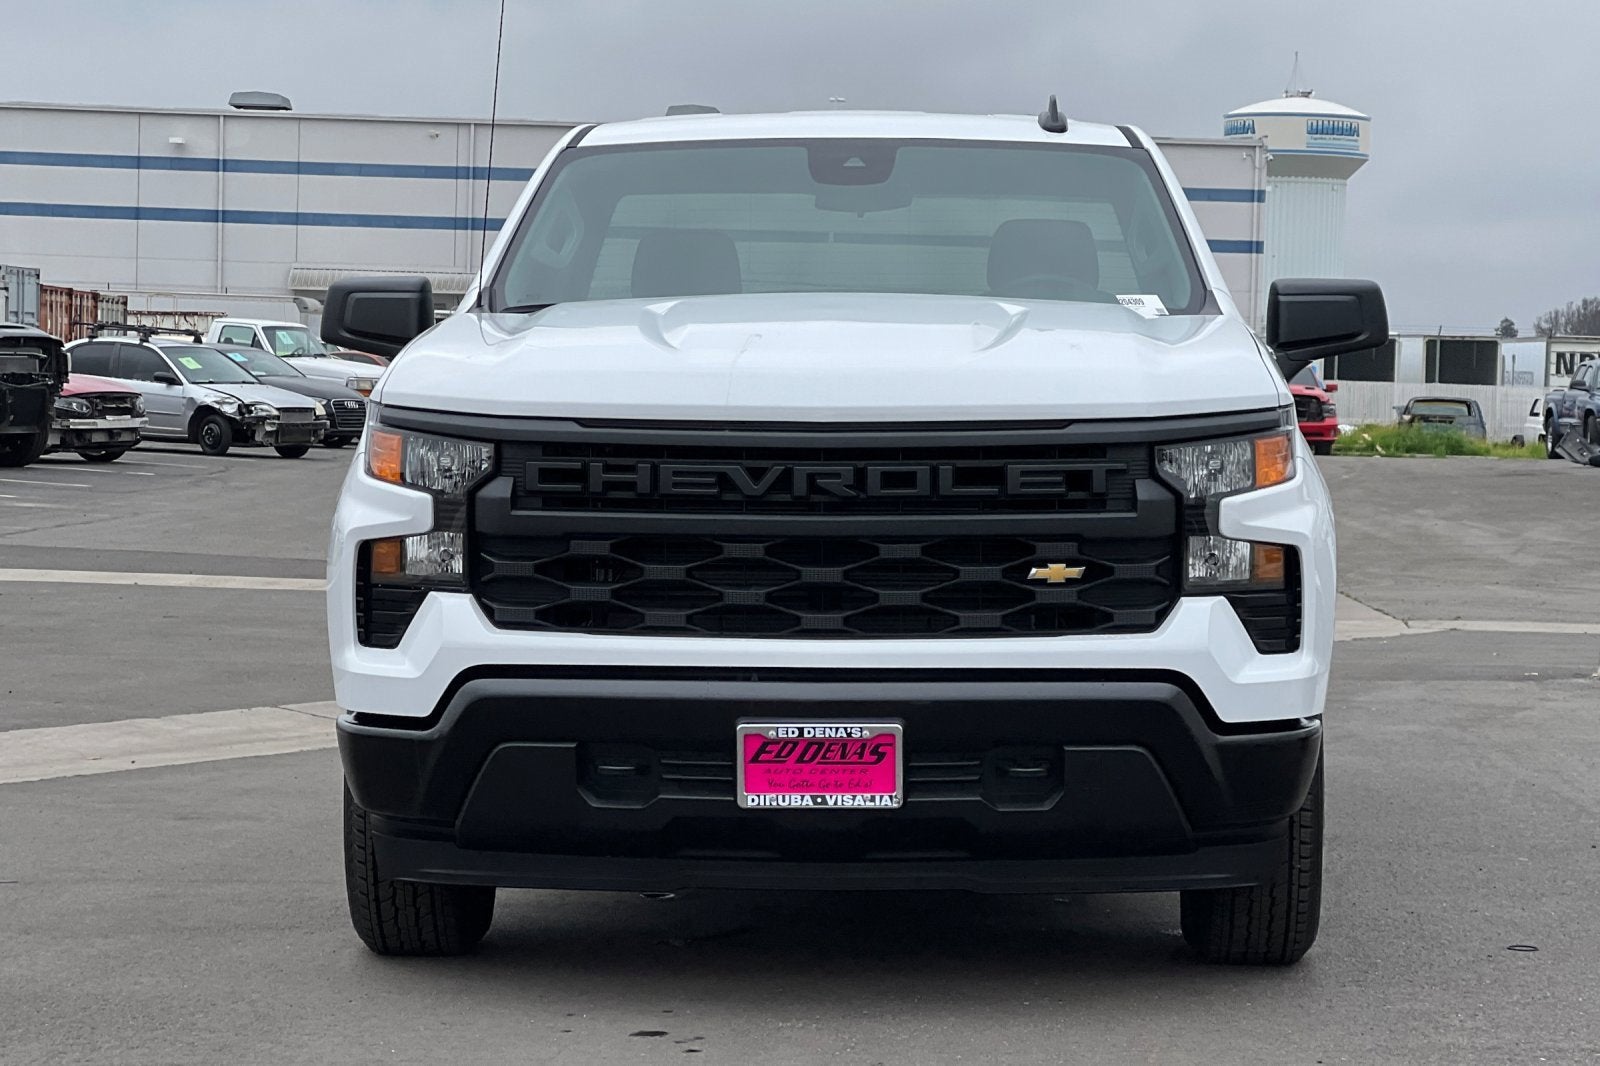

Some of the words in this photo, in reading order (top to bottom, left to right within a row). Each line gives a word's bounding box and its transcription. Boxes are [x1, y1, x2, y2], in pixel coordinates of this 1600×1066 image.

[1306, 119, 1359, 137] DINUBA
[525, 460, 1129, 498] CHEVROLET
[777, 727, 798, 738] ED
[803, 727, 862, 738] DENA'S
[748, 740, 799, 764] ED
[794, 741, 893, 765] DENA'S
[809, 767, 869, 775] CENTER
